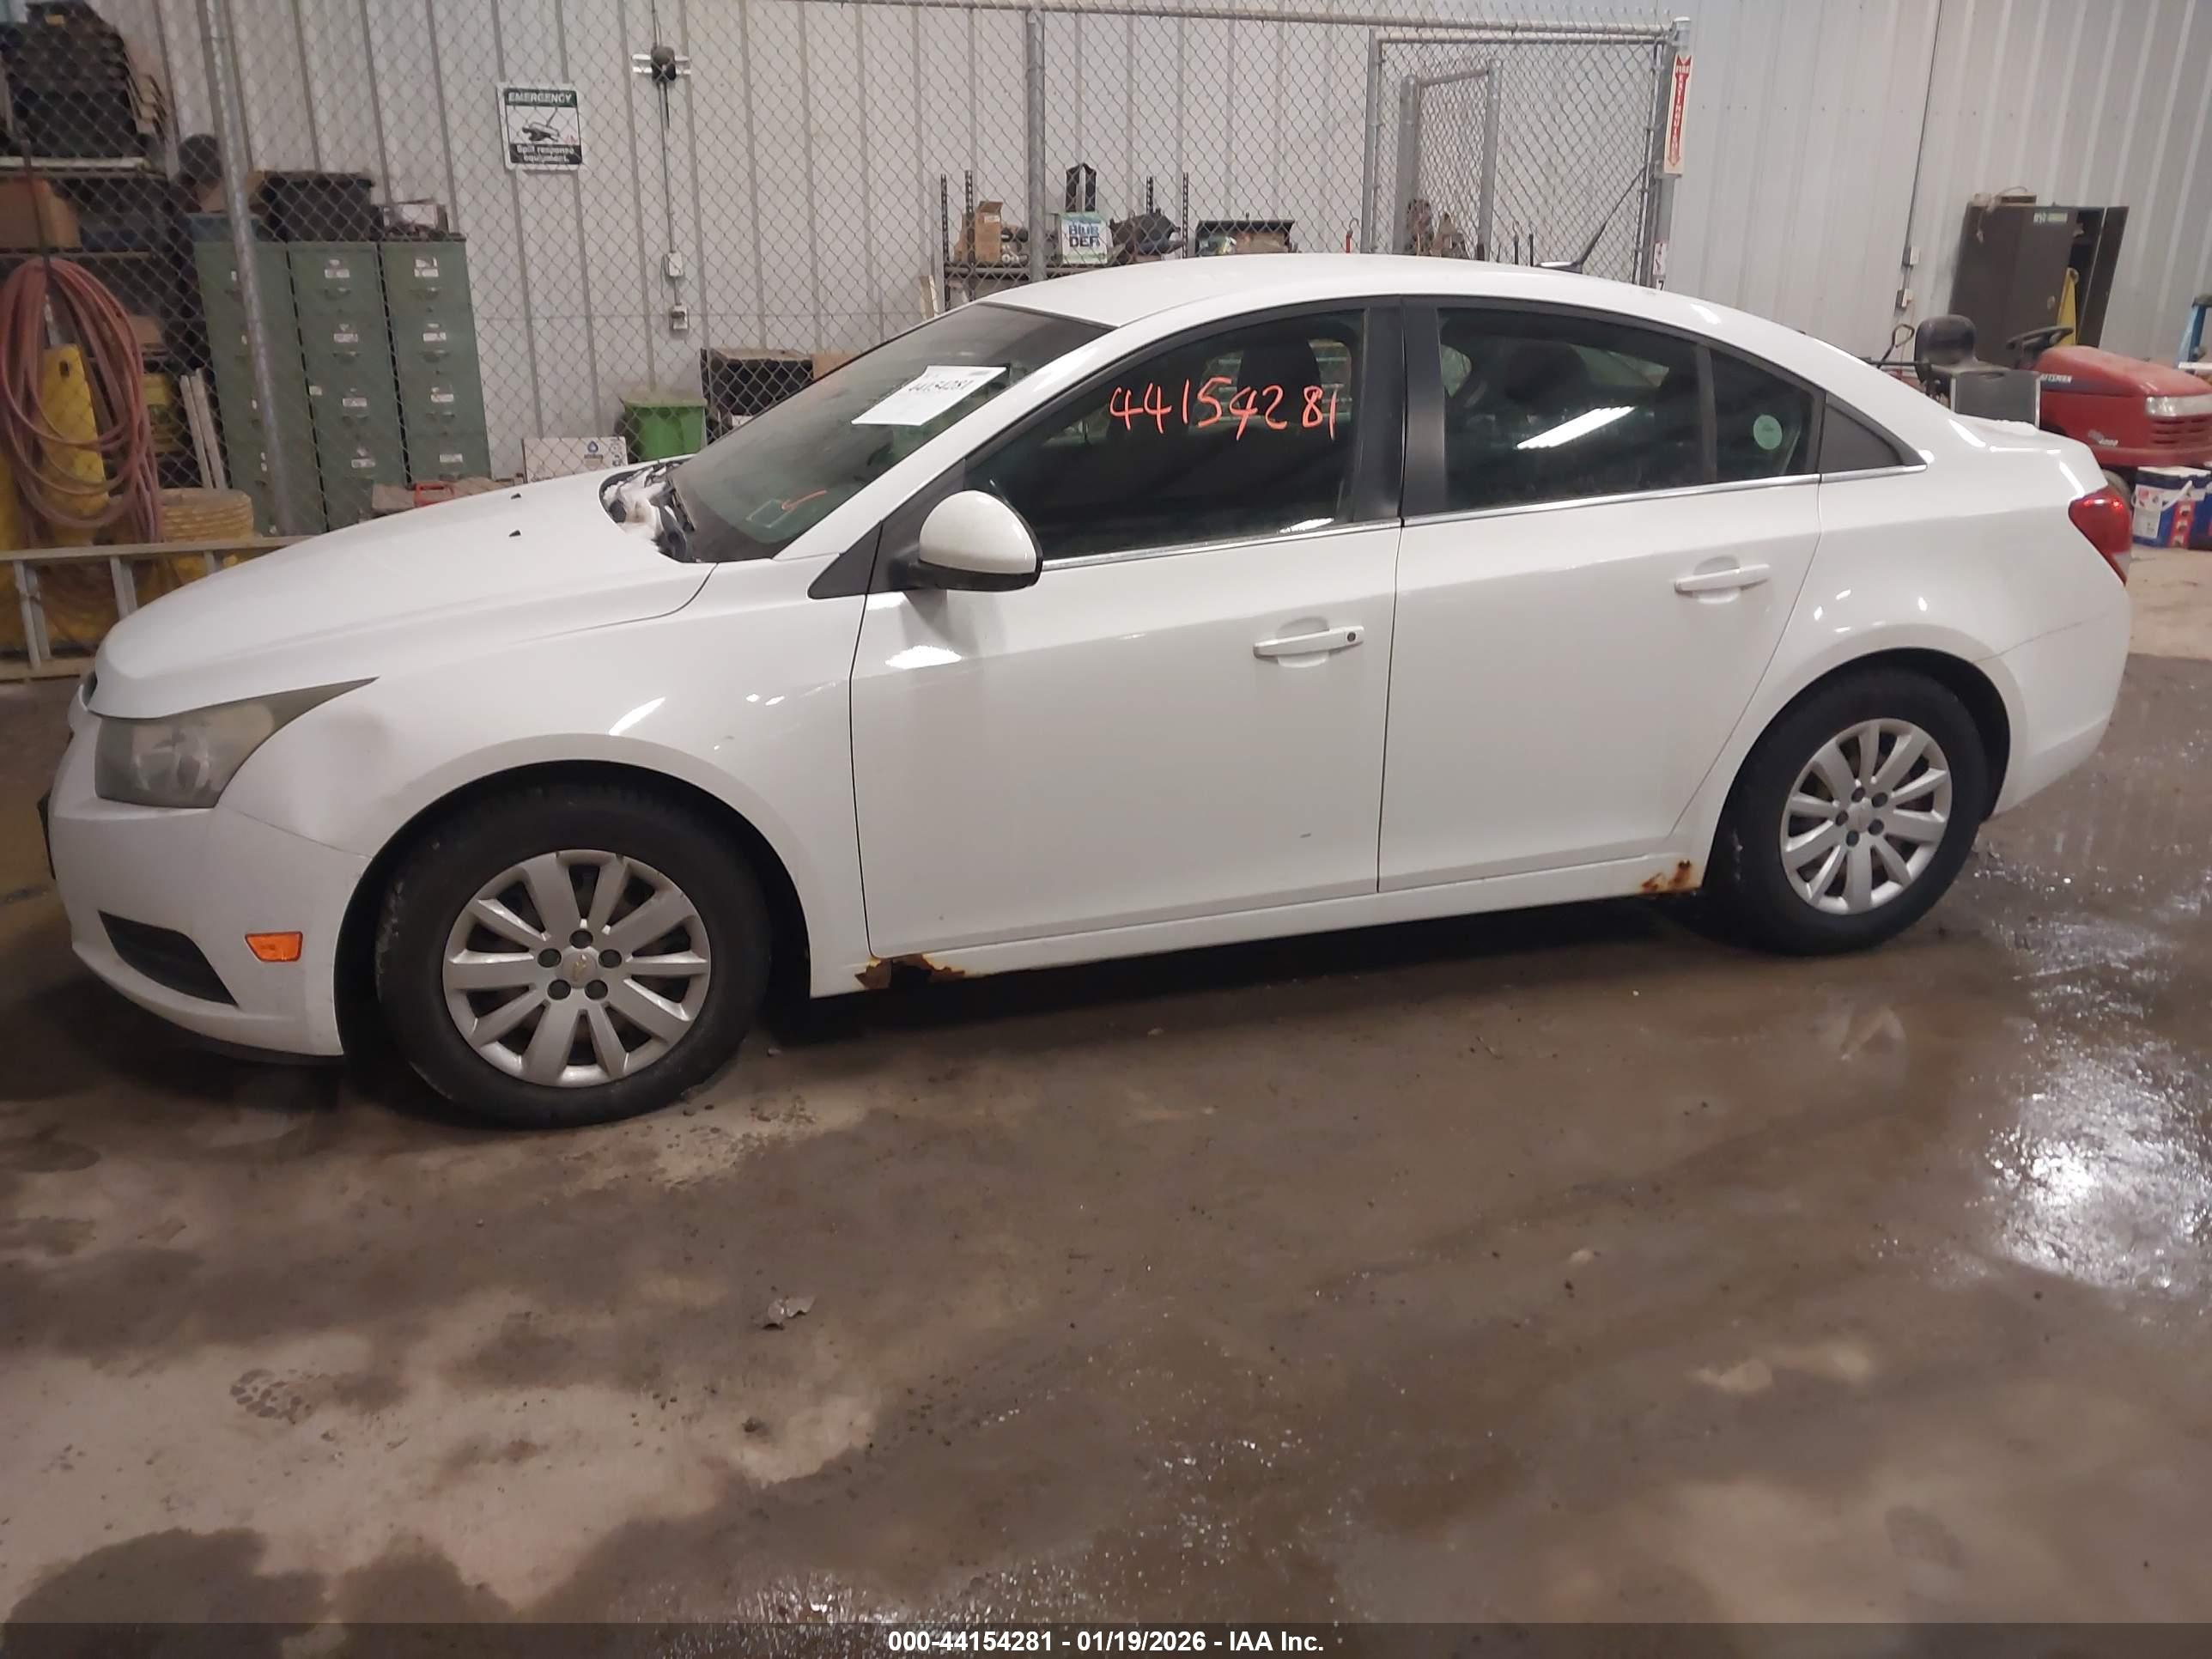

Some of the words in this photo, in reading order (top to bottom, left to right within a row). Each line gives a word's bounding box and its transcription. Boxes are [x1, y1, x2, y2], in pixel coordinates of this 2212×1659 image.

[1675, 64, 1690, 75] FIRE
[508, 92, 572, 103] EMERGENCY
[537, 146, 574, 157] response
[1069, 235, 1100, 247] DEF
[1109, 376, 1339, 441] 44154281
